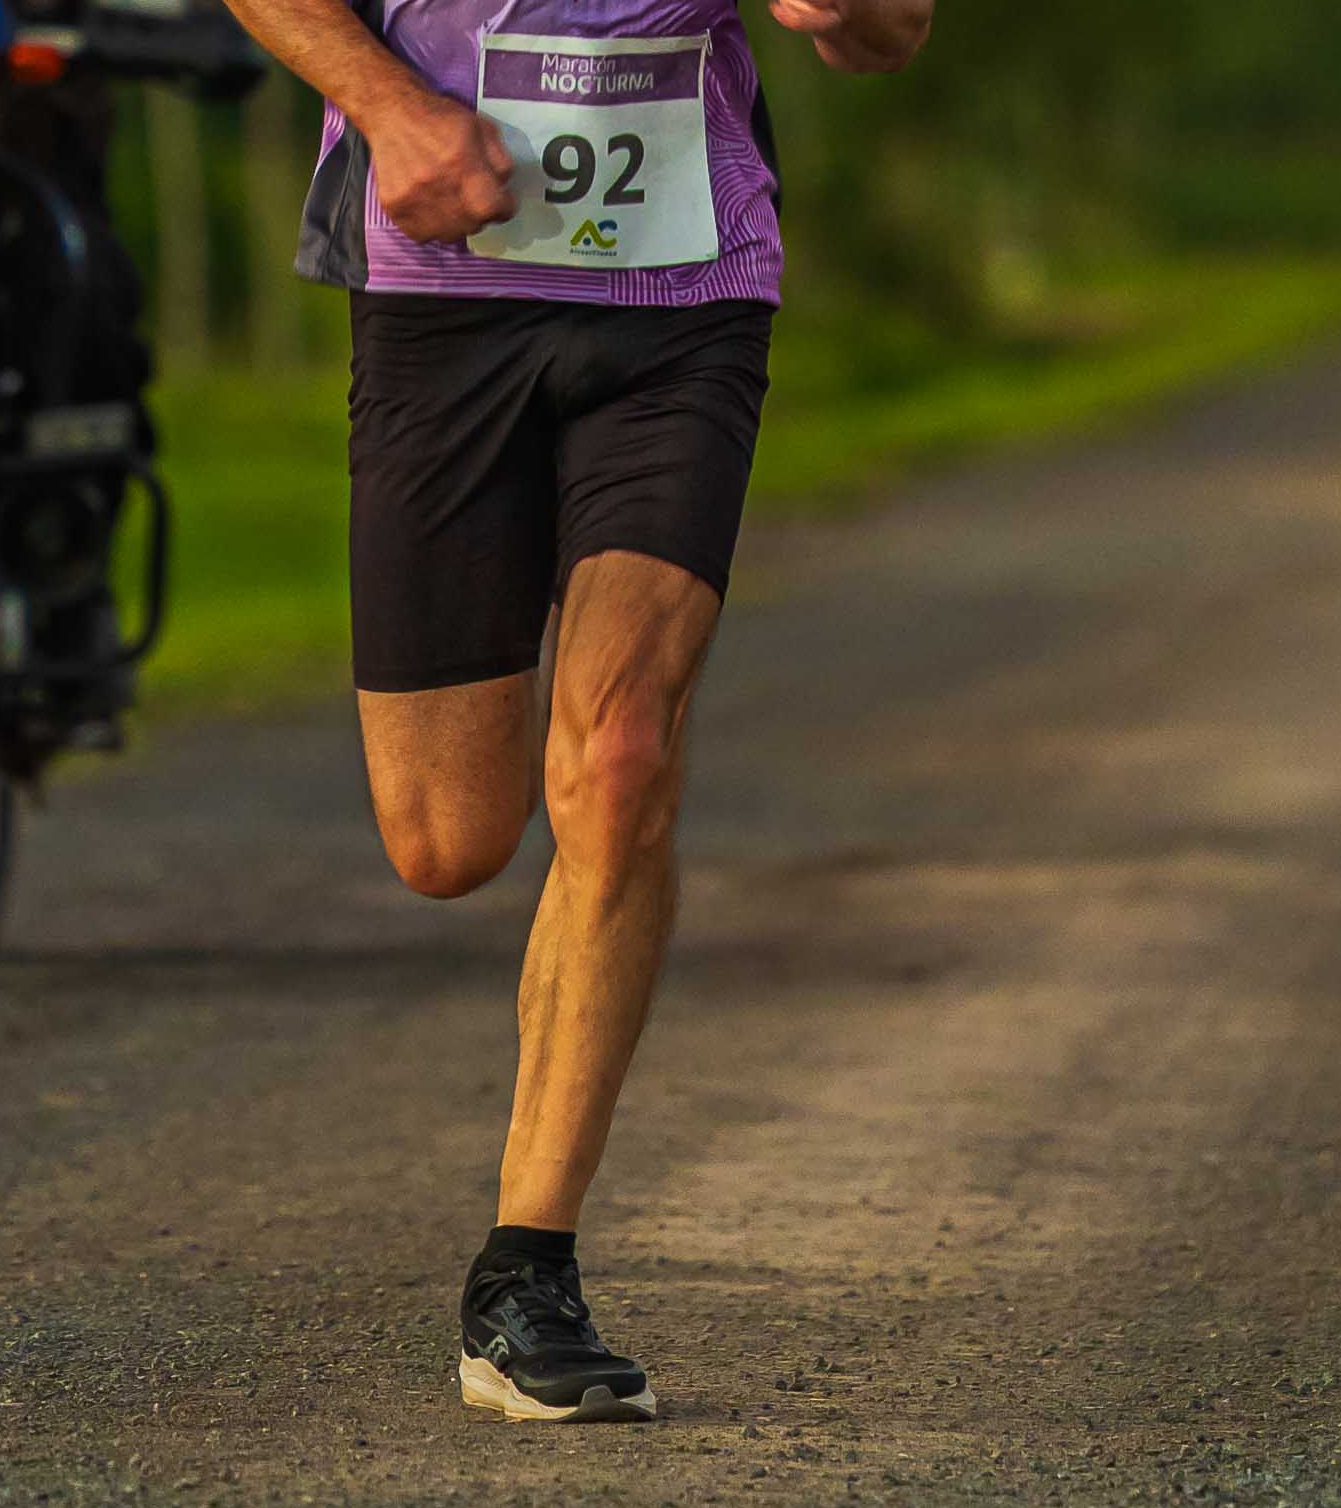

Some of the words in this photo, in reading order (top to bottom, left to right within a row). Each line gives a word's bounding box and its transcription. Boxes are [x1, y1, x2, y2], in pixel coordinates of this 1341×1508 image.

[541, 53, 616, 74] Maratón
[540, 71, 655, 95] NOCTURNA
[542, 134, 645, 206] 92
